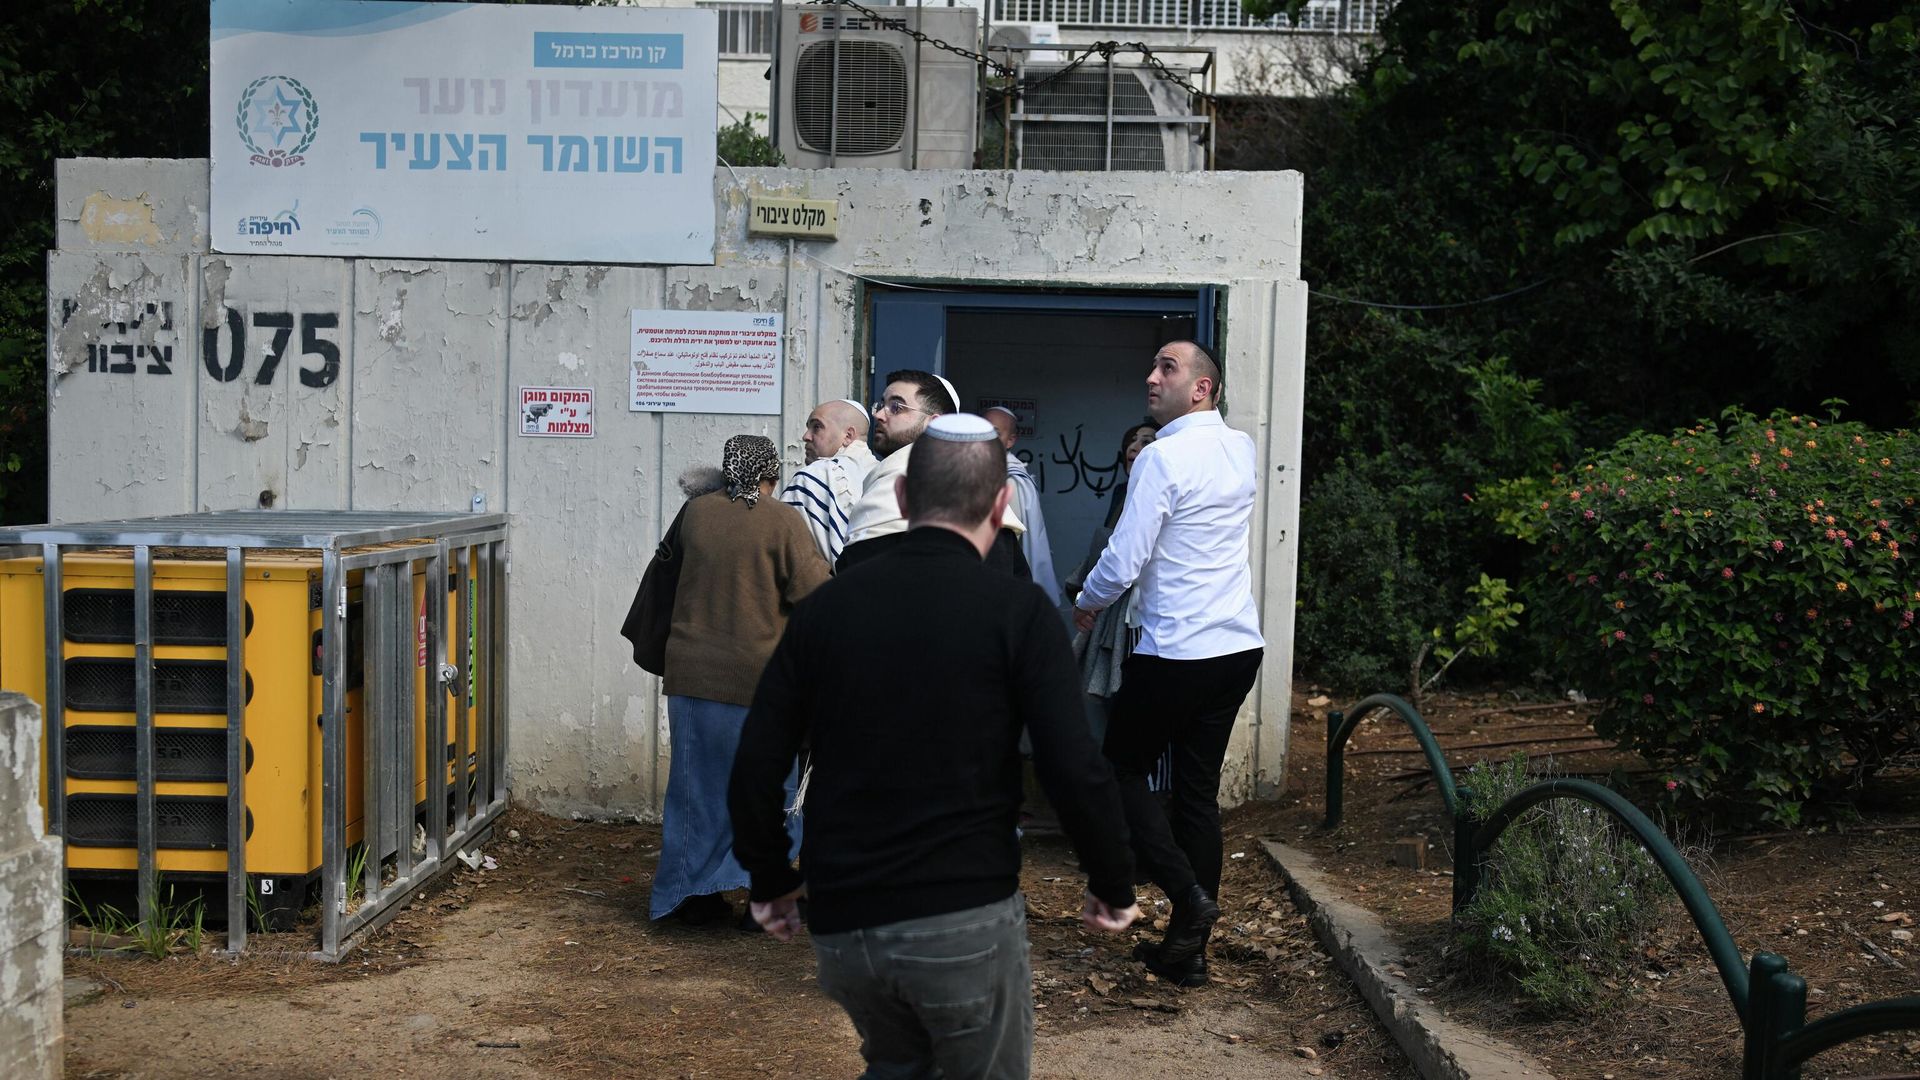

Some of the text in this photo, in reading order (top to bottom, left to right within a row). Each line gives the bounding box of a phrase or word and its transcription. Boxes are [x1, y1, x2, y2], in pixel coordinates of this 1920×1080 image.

[551, 42, 667, 63] קן מרכז כרמל
[403, 77, 684, 125] מועדון נוער
[360, 132, 683, 174] השומר הצעיר
[757, 203, 825, 231] מקלט ציבורי
[249, 222, 292, 235] חיפה
[714, 338, 732, 346] למשוך
[757, 330, 777, 338] במקלט
[203, 307, 341, 388] 075
[524, 391, 590, 405] המקום מוגן
[547, 420, 590, 433] מצלמות
